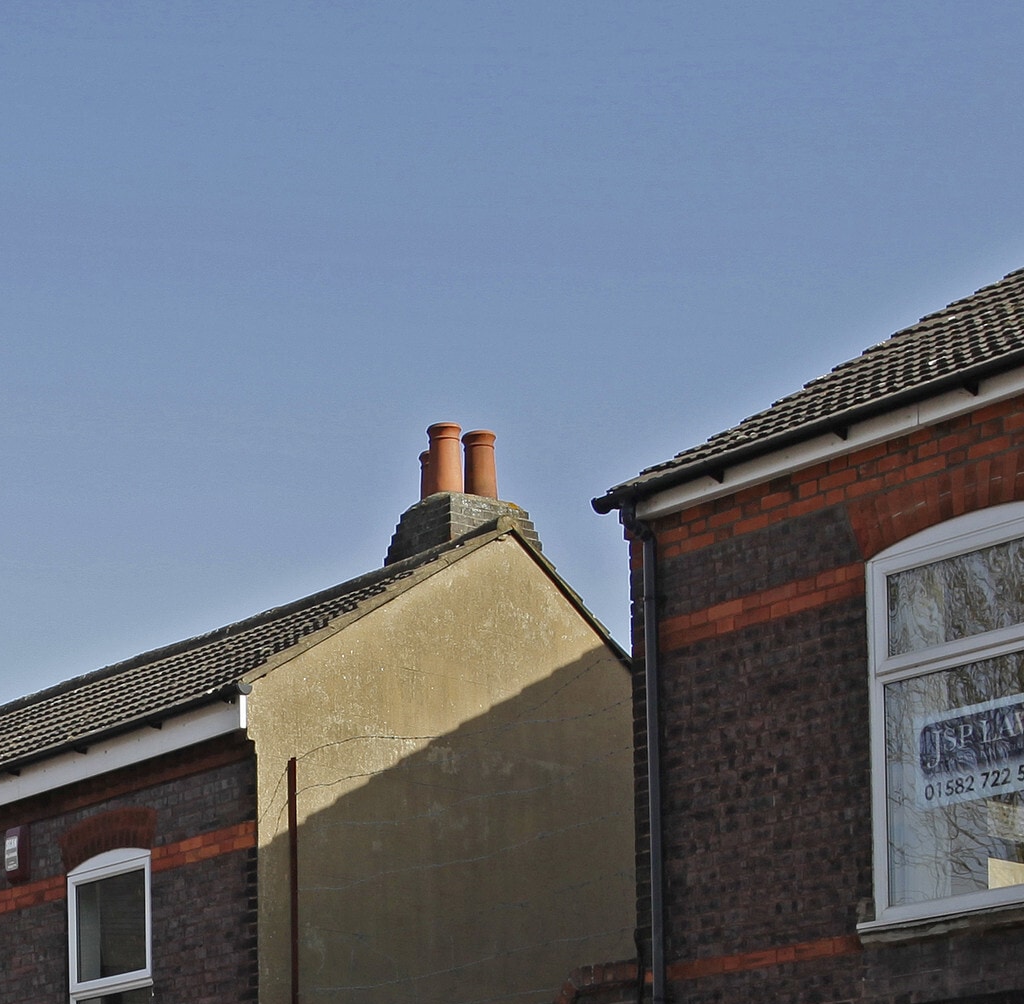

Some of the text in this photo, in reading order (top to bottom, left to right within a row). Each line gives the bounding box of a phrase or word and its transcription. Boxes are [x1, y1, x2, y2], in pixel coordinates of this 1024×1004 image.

[927, 724, 973, 769] JSP
[925, 775, 974, 800] 01582
[980, 767, 1011, 788] 722
